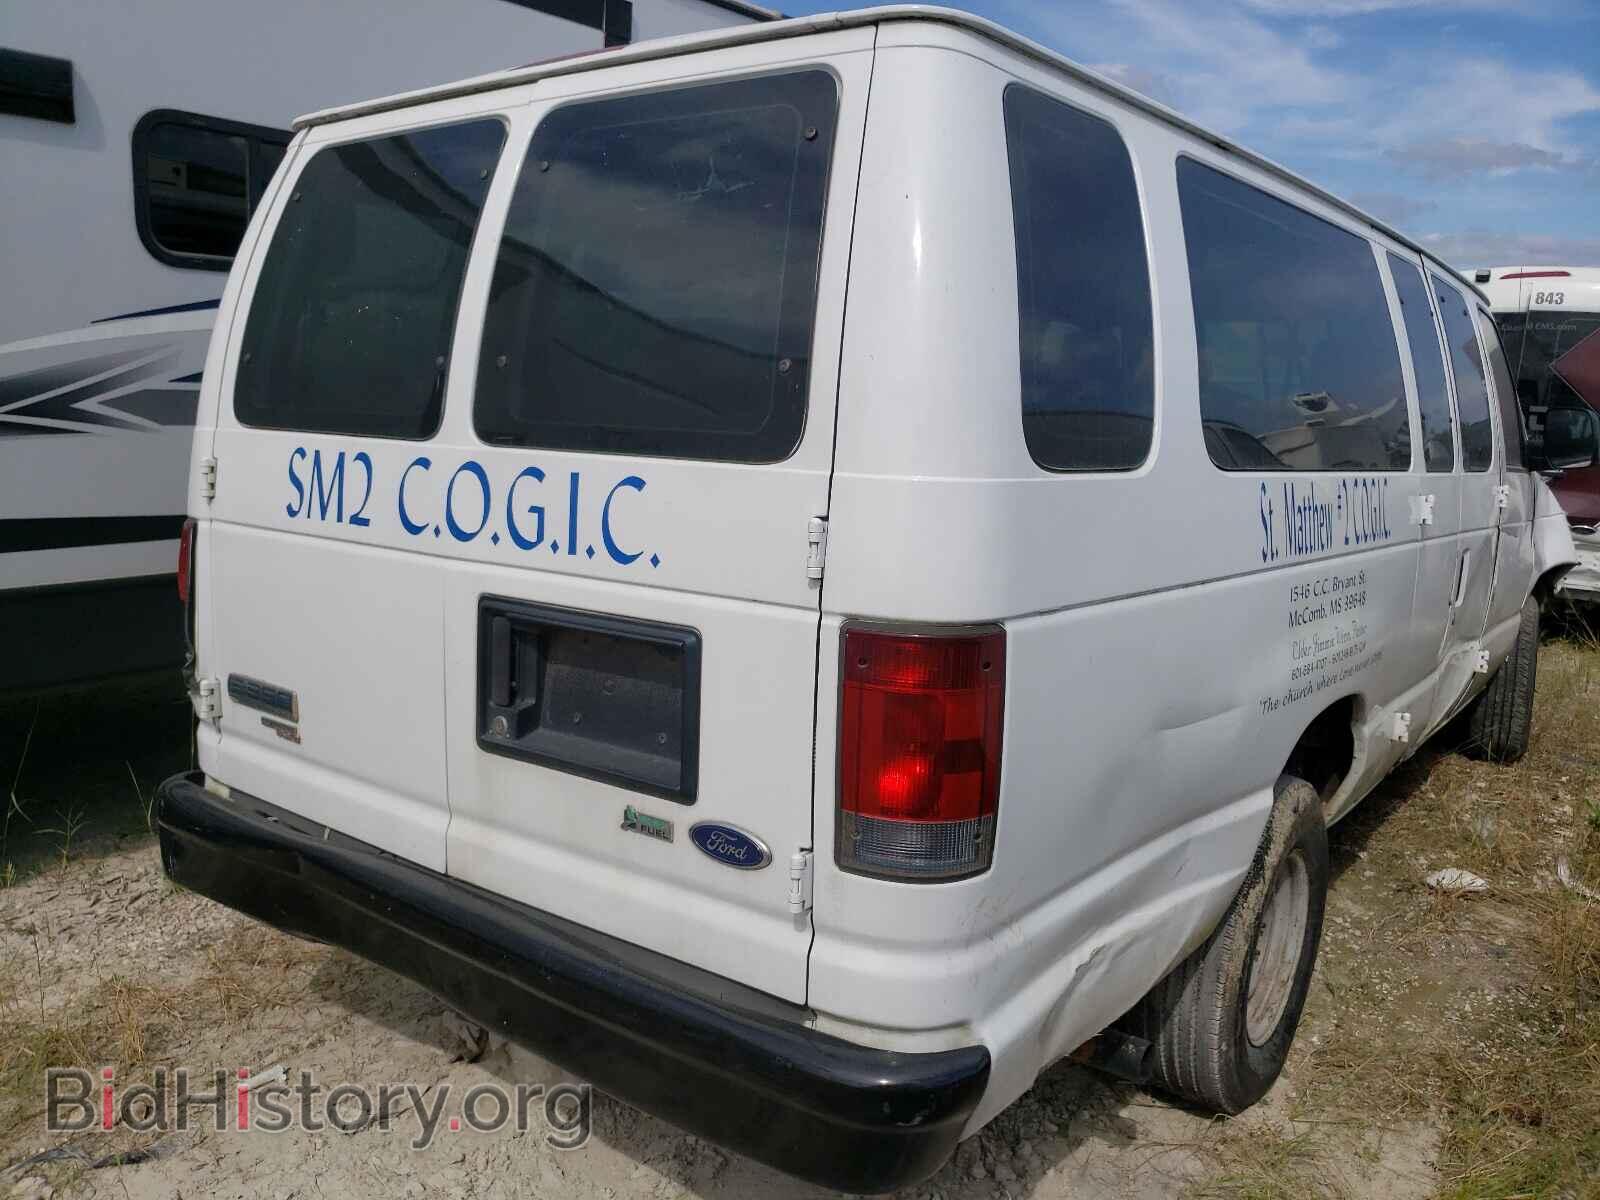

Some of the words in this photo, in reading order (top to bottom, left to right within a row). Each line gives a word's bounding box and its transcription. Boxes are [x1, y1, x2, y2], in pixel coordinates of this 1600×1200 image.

[1535, 291, 1565, 305] 843
[286, 446, 373, 527] SM2
[398, 456, 661, 569] C.O.G.I.C.
[1260, 481, 1279, 563] St.
[1283, 480, 1333, 557] Matthew
[1289, 583, 1311, 603] 1546
[1332, 575, 1356, 592] Bryant
[1330, 597, 1342, 617] MS
[1282, 680, 1313, 707] church
[640, 823, 669, 842] FUEL
[706, 830, 748, 860] Ford
